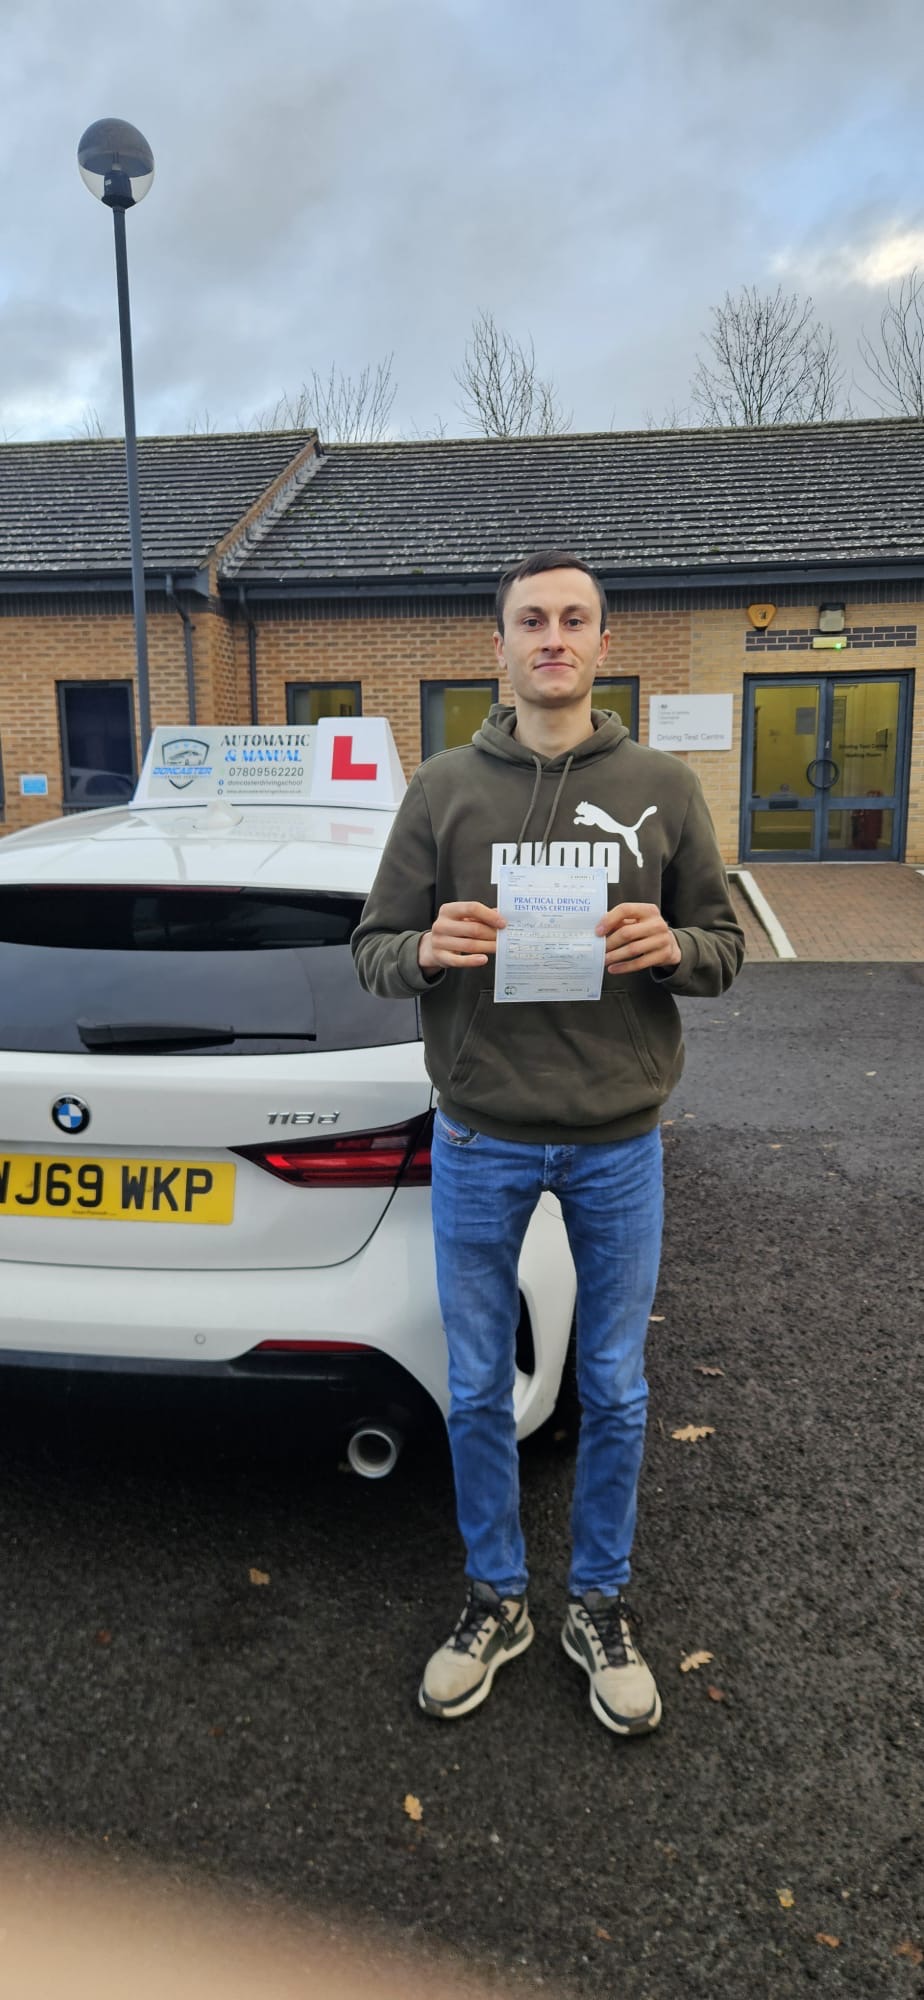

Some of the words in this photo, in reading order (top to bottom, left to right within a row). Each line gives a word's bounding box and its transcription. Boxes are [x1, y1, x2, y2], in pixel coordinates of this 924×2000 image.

[221, 734, 310, 747] AUTOMATIC
[657, 734, 682, 742] Driving
[684, 733, 699, 741] Test
[701, 733, 725, 741] Centre
[224, 749, 237, 762] &
[242, 749, 303, 762] MANUAL
[331, 736, 377, 780] L
[152, 767, 213, 776] DONCASTER
[228, 767, 304, 777] 07809562220
[513, 896, 554, 905] PRACTICAL
[557, 897, 591, 905] DRIVING
[531, 904, 548, 912] PASS
[549, 904, 590, 912] CERTIFICATE
[121, 1165, 213, 1212] WKP
